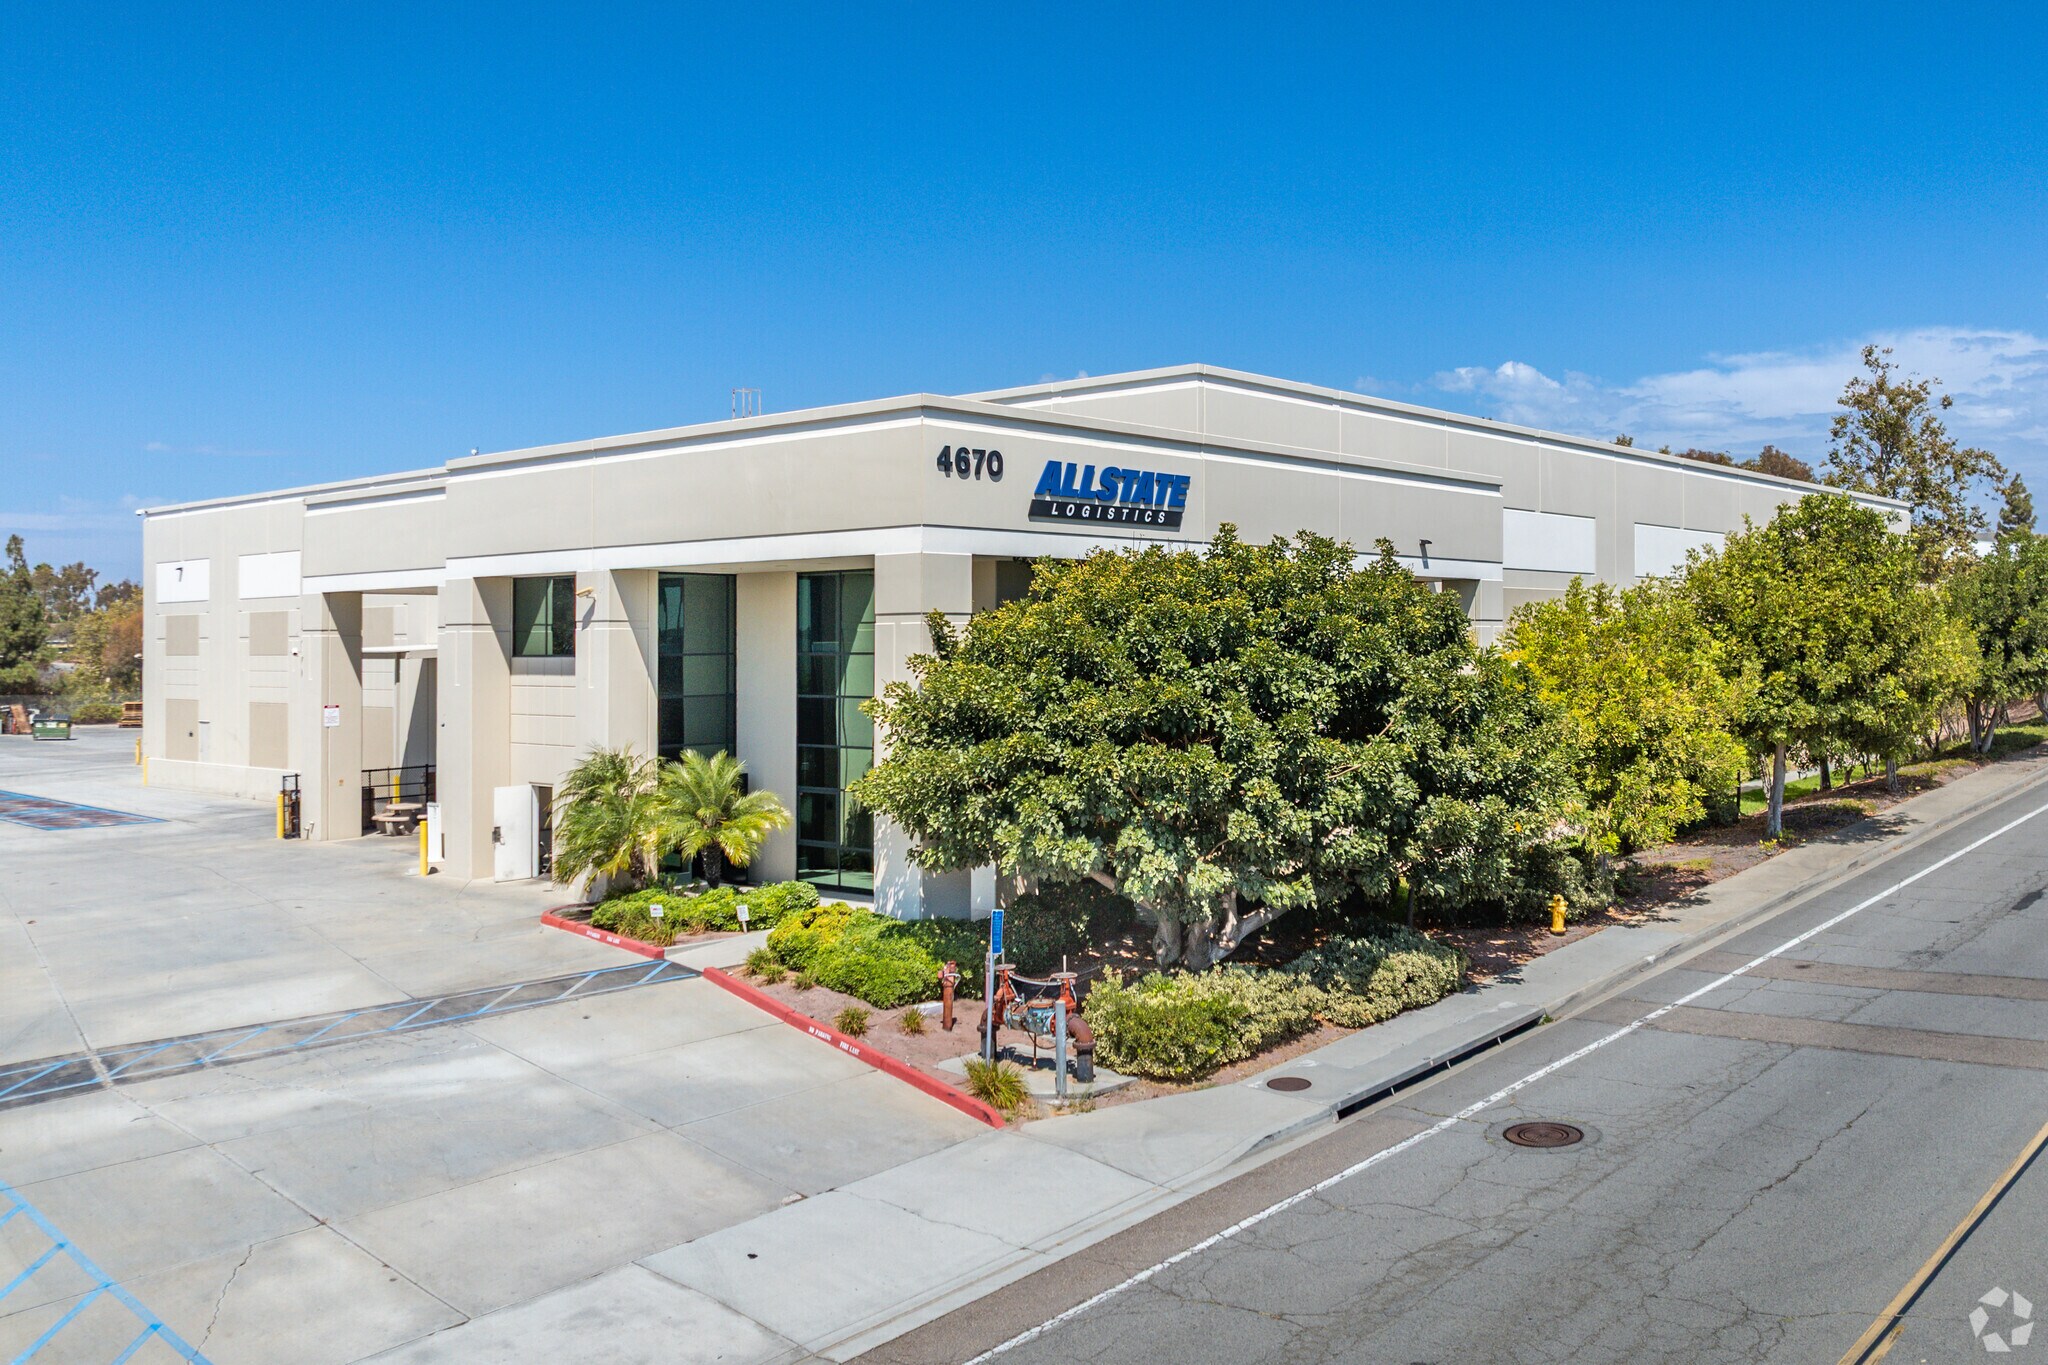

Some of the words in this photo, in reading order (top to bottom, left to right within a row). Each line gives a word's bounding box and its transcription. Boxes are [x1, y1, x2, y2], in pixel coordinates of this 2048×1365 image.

[937, 445, 1004, 482] 4670
[1034, 460, 1191, 508] ALLSTATE
[1051, 502, 1166, 524] LOGISTICS
